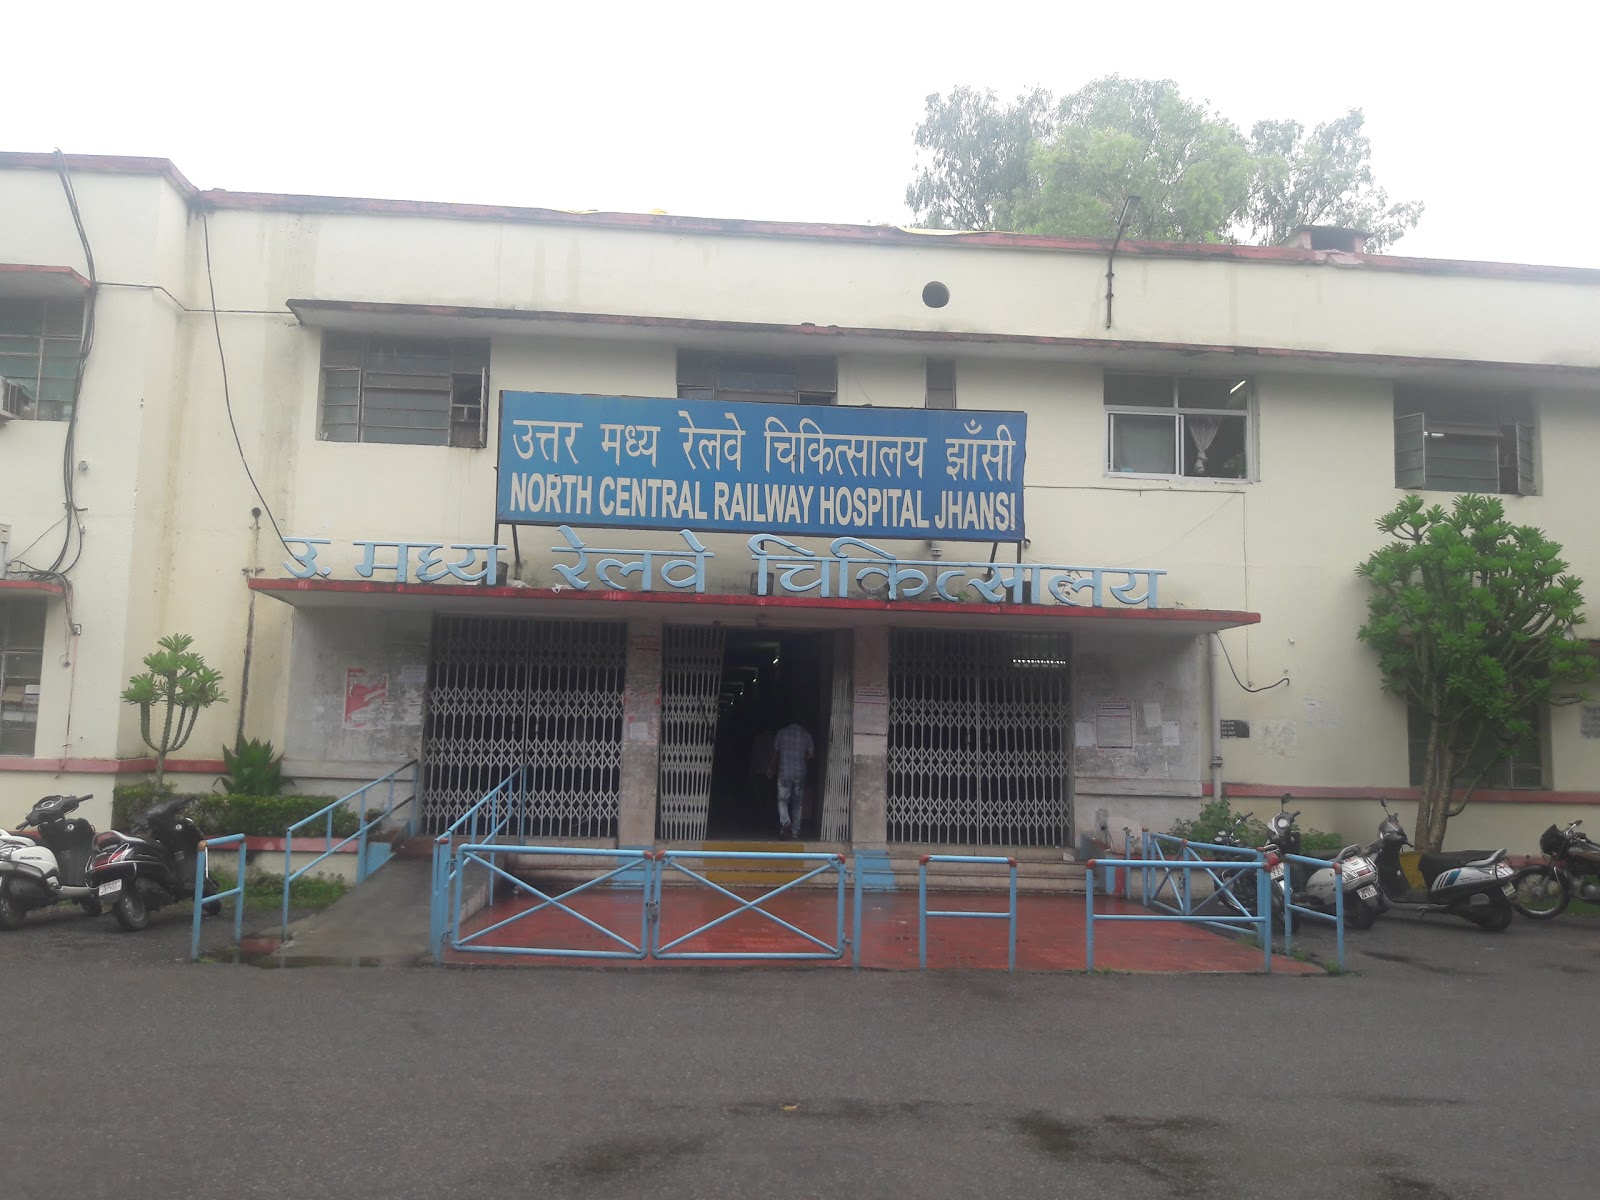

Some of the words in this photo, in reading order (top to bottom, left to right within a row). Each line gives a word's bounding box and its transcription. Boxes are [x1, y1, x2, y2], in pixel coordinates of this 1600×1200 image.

[512, 419, 584, 465] उत्तर
[600, 423, 662, 469] मध्य
[678, 410, 746, 473] रेलवे
[763, 416, 928, 479] चिकित्सालय
[945, 419, 1017, 482] झाँसी
[510, 472, 593, 515] NORTH
[600, 475, 708, 520] CENTRAL
[714, 481, 814, 525] RAILWAY
[820, 486, 930, 528] HOSPITAL
[934, 490, 1016, 532] JHANSI
[352, 540, 507, 586] मध्य
[551, 524, 715, 594] रेलवे
[747, 533, 1168, 610] चिकित्सालय
